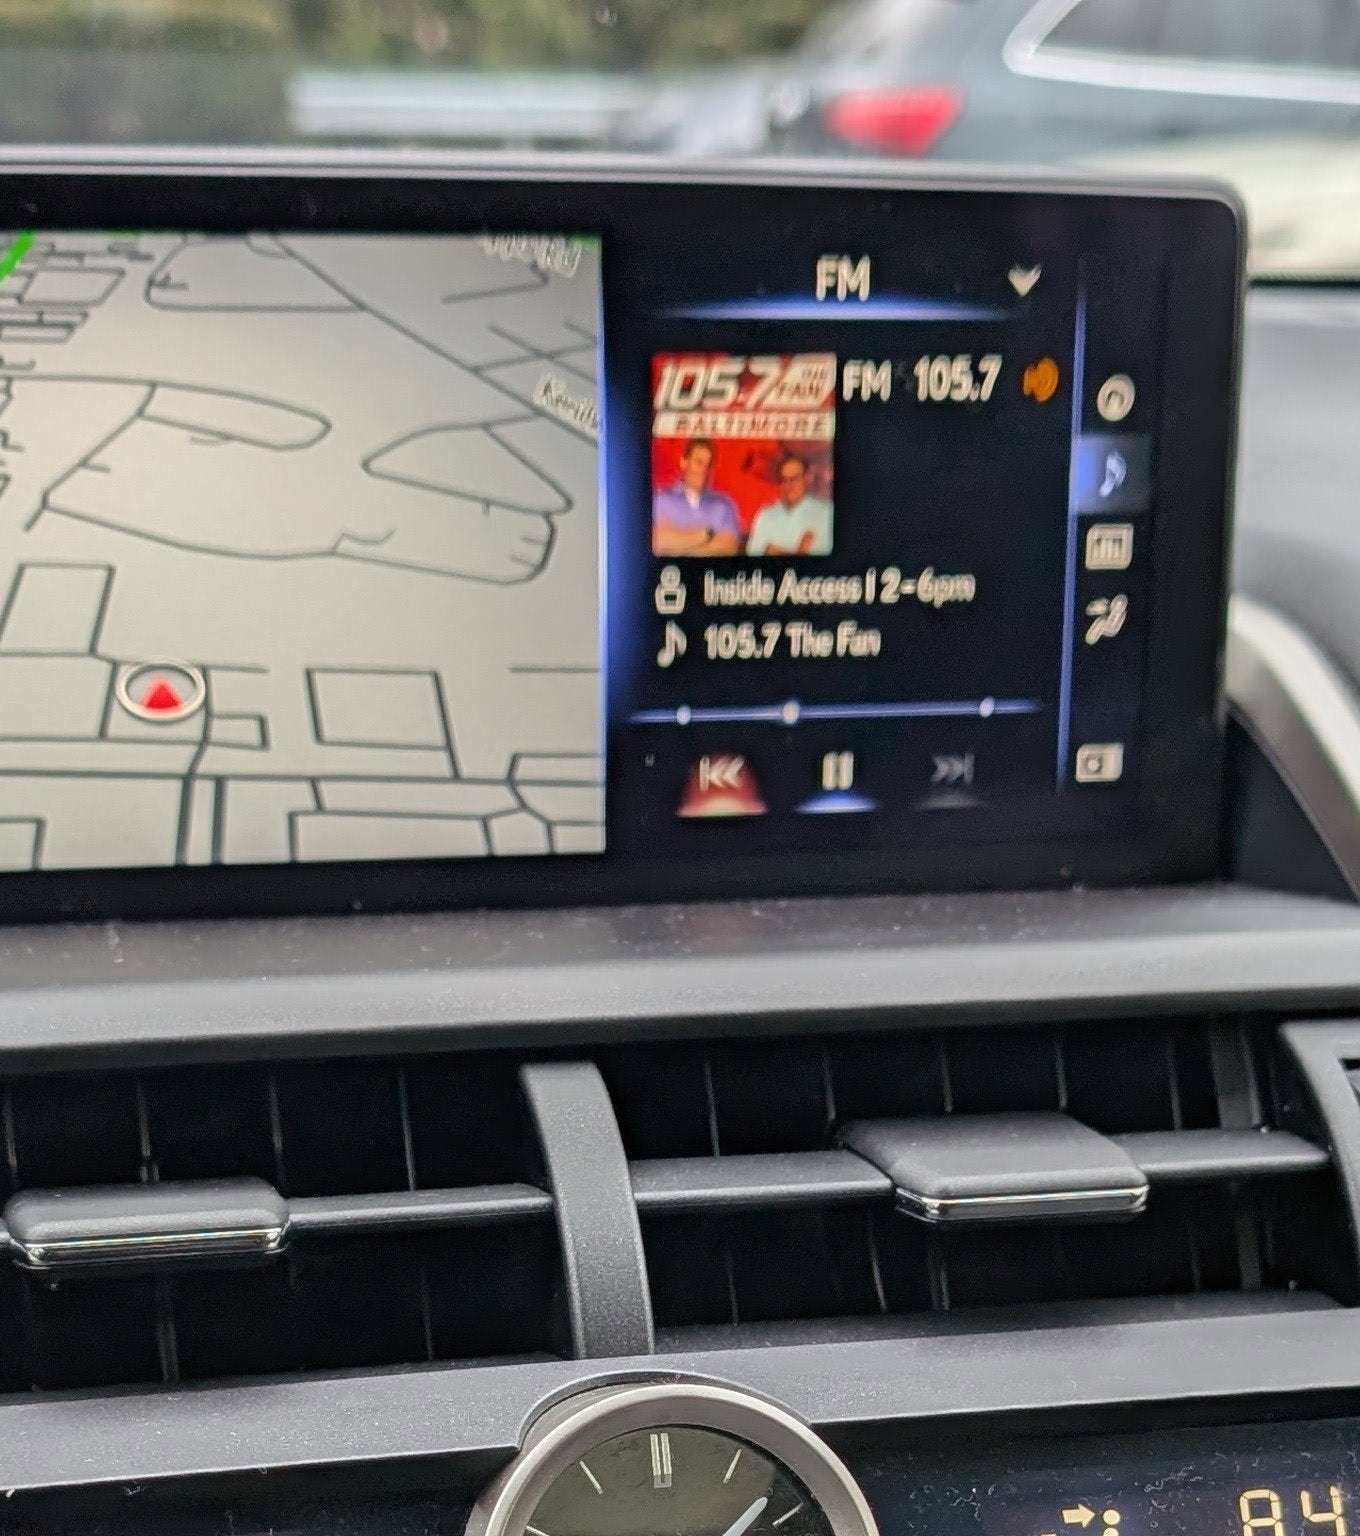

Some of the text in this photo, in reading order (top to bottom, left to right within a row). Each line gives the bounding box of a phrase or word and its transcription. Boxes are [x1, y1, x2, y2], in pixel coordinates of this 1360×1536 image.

[815, 254, 871, 301] FM
[842, 353, 1003, 402] FM 105.7
[704, 568, 775, 606] Inside
[776, 567, 862, 605] Access
[704, 619, 882, 660] 105.7 The Fan
